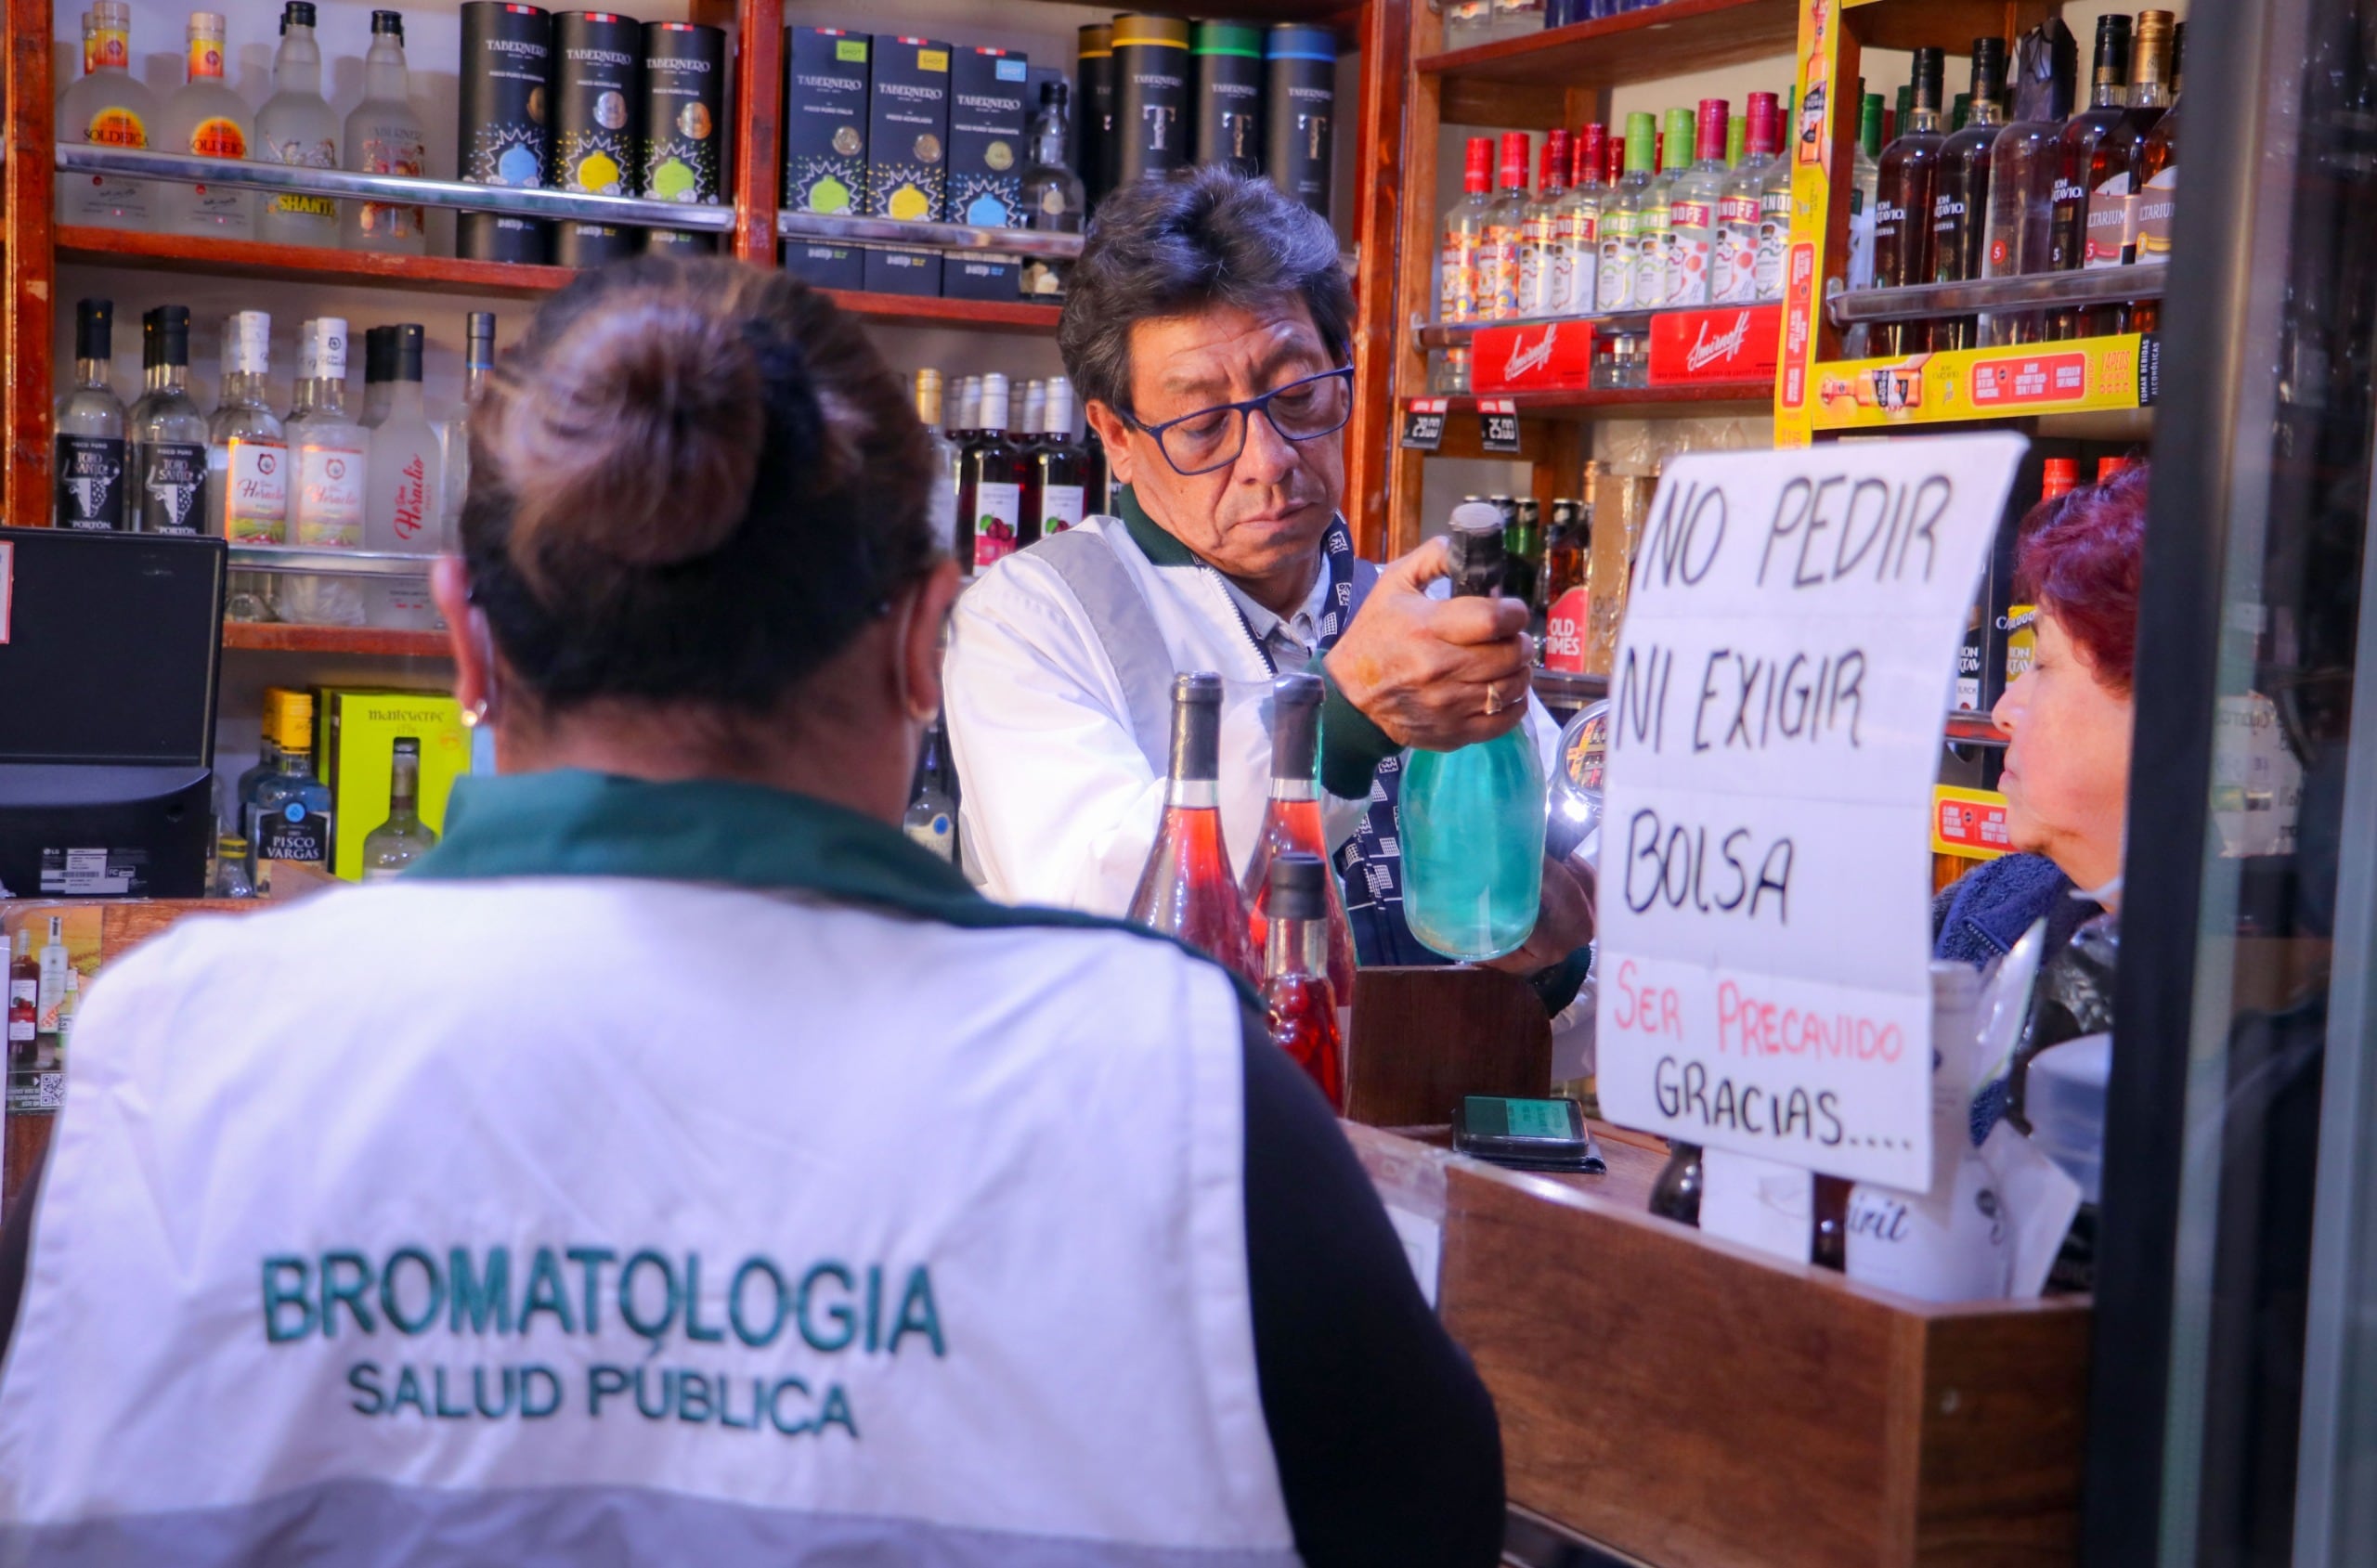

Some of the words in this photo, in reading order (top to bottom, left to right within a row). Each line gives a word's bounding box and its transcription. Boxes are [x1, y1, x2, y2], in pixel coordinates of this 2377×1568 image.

[566, 48, 632, 66] TABERNERO
[646, 58, 711, 73] TABERNERO
[797, 75, 863, 91] TABERNERO
[878, 84, 942, 99] TABERNERO
[956, 95, 1020, 110] TABERNERO
[1994, 246, 2001, 259] 5
[2053, 248, 2059, 262] 5
[2086, 243, 2094, 257] 5
[1686, 311, 1750, 372] Smirnoff
[2139, 339, 2150, 373] BEBIDAS
[2140, 376, 2149, 403] TOMAR
[1642, 479, 1727, 590] NO
[1756, 473, 1952, 590] PEDIR
[1549, 617, 1575, 636] OLD
[1546, 636, 1580, 656] TIMES
[1614, 644, 1671, 755] NI
[1693, 648, 1865, 756] EXIGIR
[272, 836, 316, 849] PISCO
[266, 846, 320, 860] VARGAS
[1624, 809, 1795, 927] BOLSA
[1614, 959, 1682, 1041] SER
[1717, 980, 1905, 1063] PRECAVIDO
[261, 1244, 947, 1358] BROMATOLOGIA
[346, 1361, 565, 1419] SALUD
[587, 1341, 860, 1440] PÚBLICA
